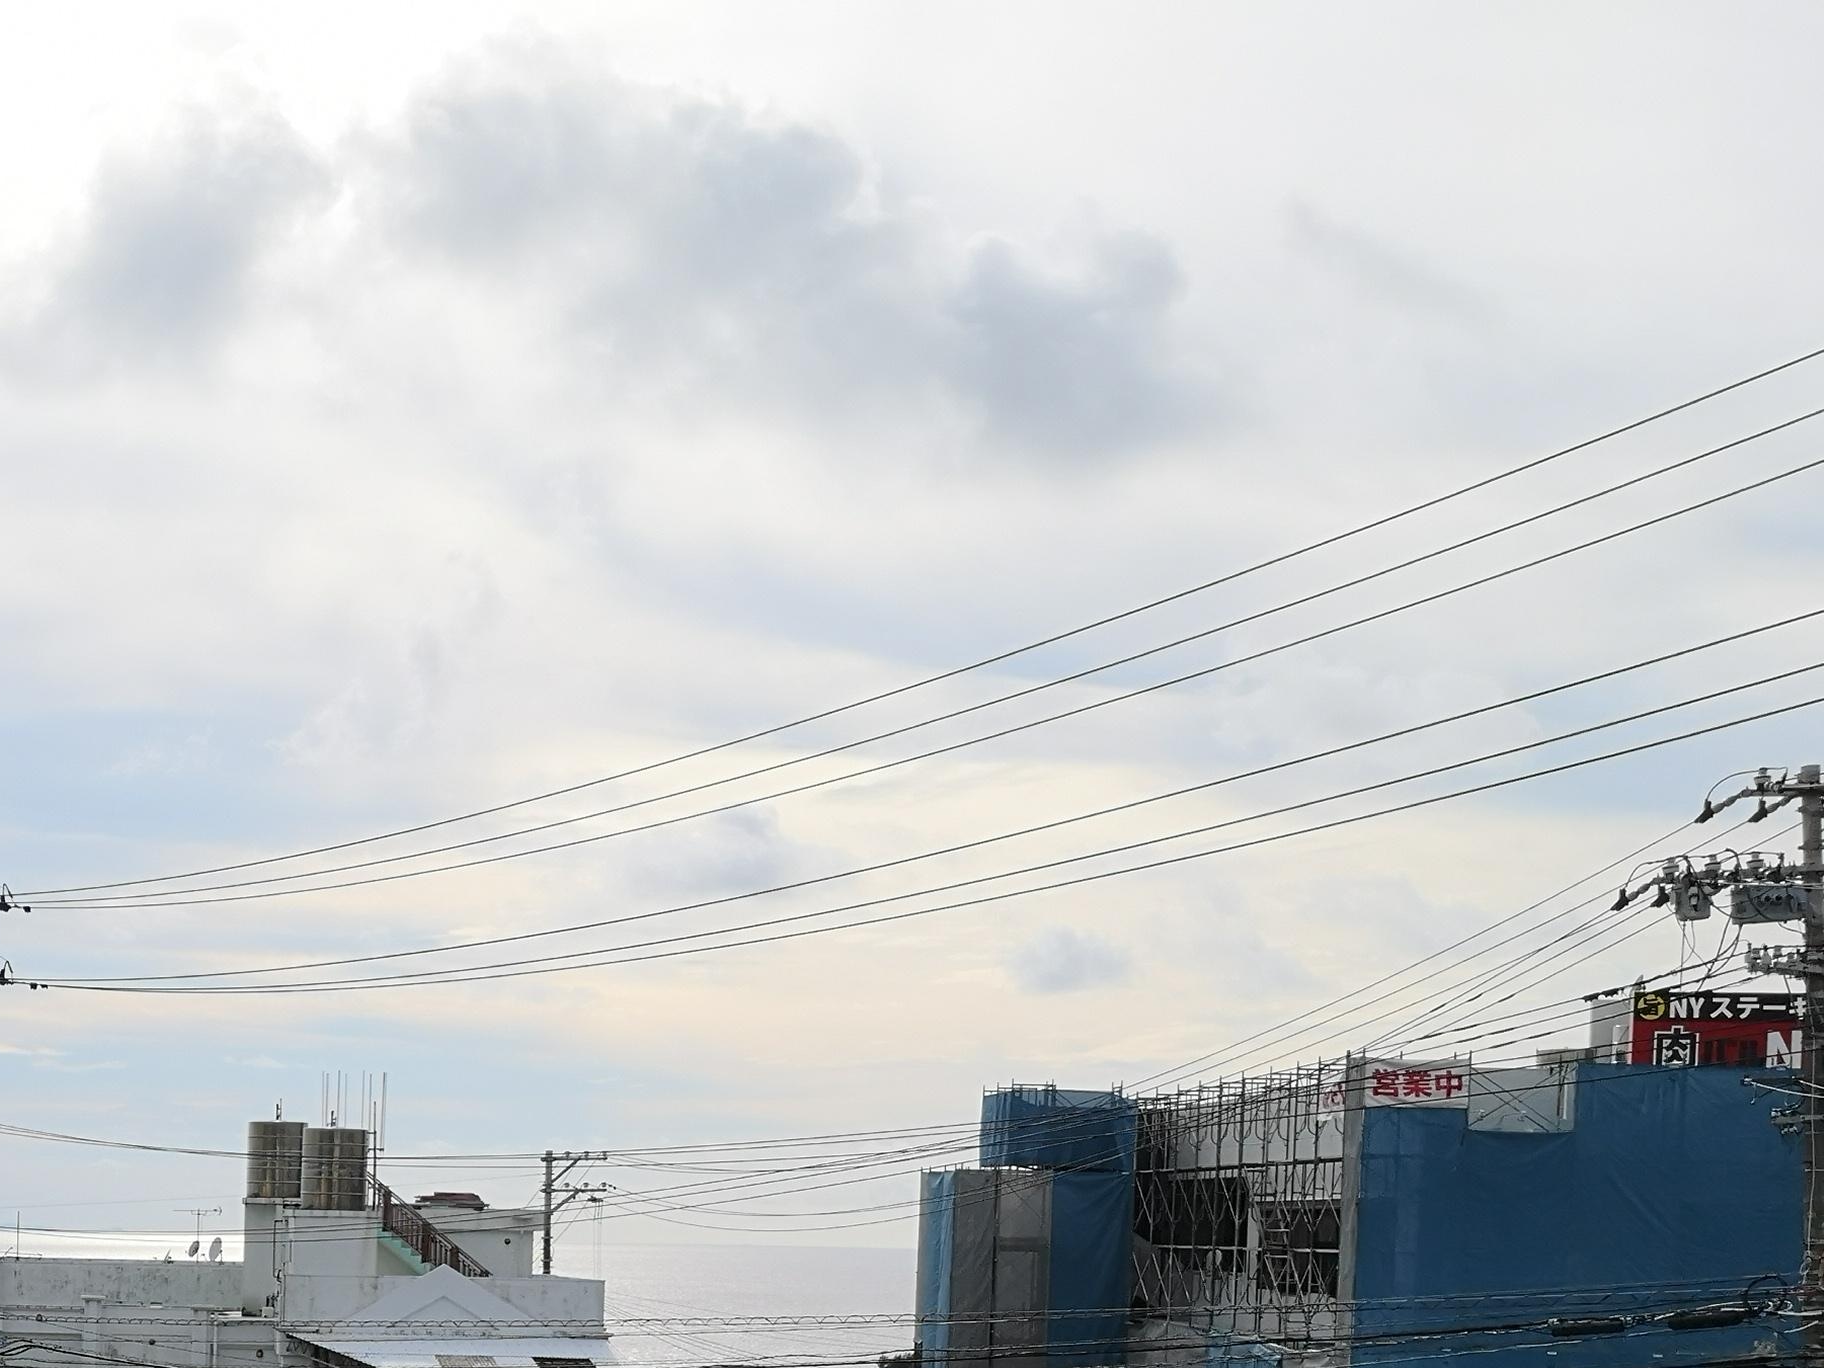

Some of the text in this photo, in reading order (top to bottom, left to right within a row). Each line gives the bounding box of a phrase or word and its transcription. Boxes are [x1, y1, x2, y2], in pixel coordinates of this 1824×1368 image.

[1653, 1025, 1700, 1067] 肉
[1372, 1069, 1463, 1098] 営業中
